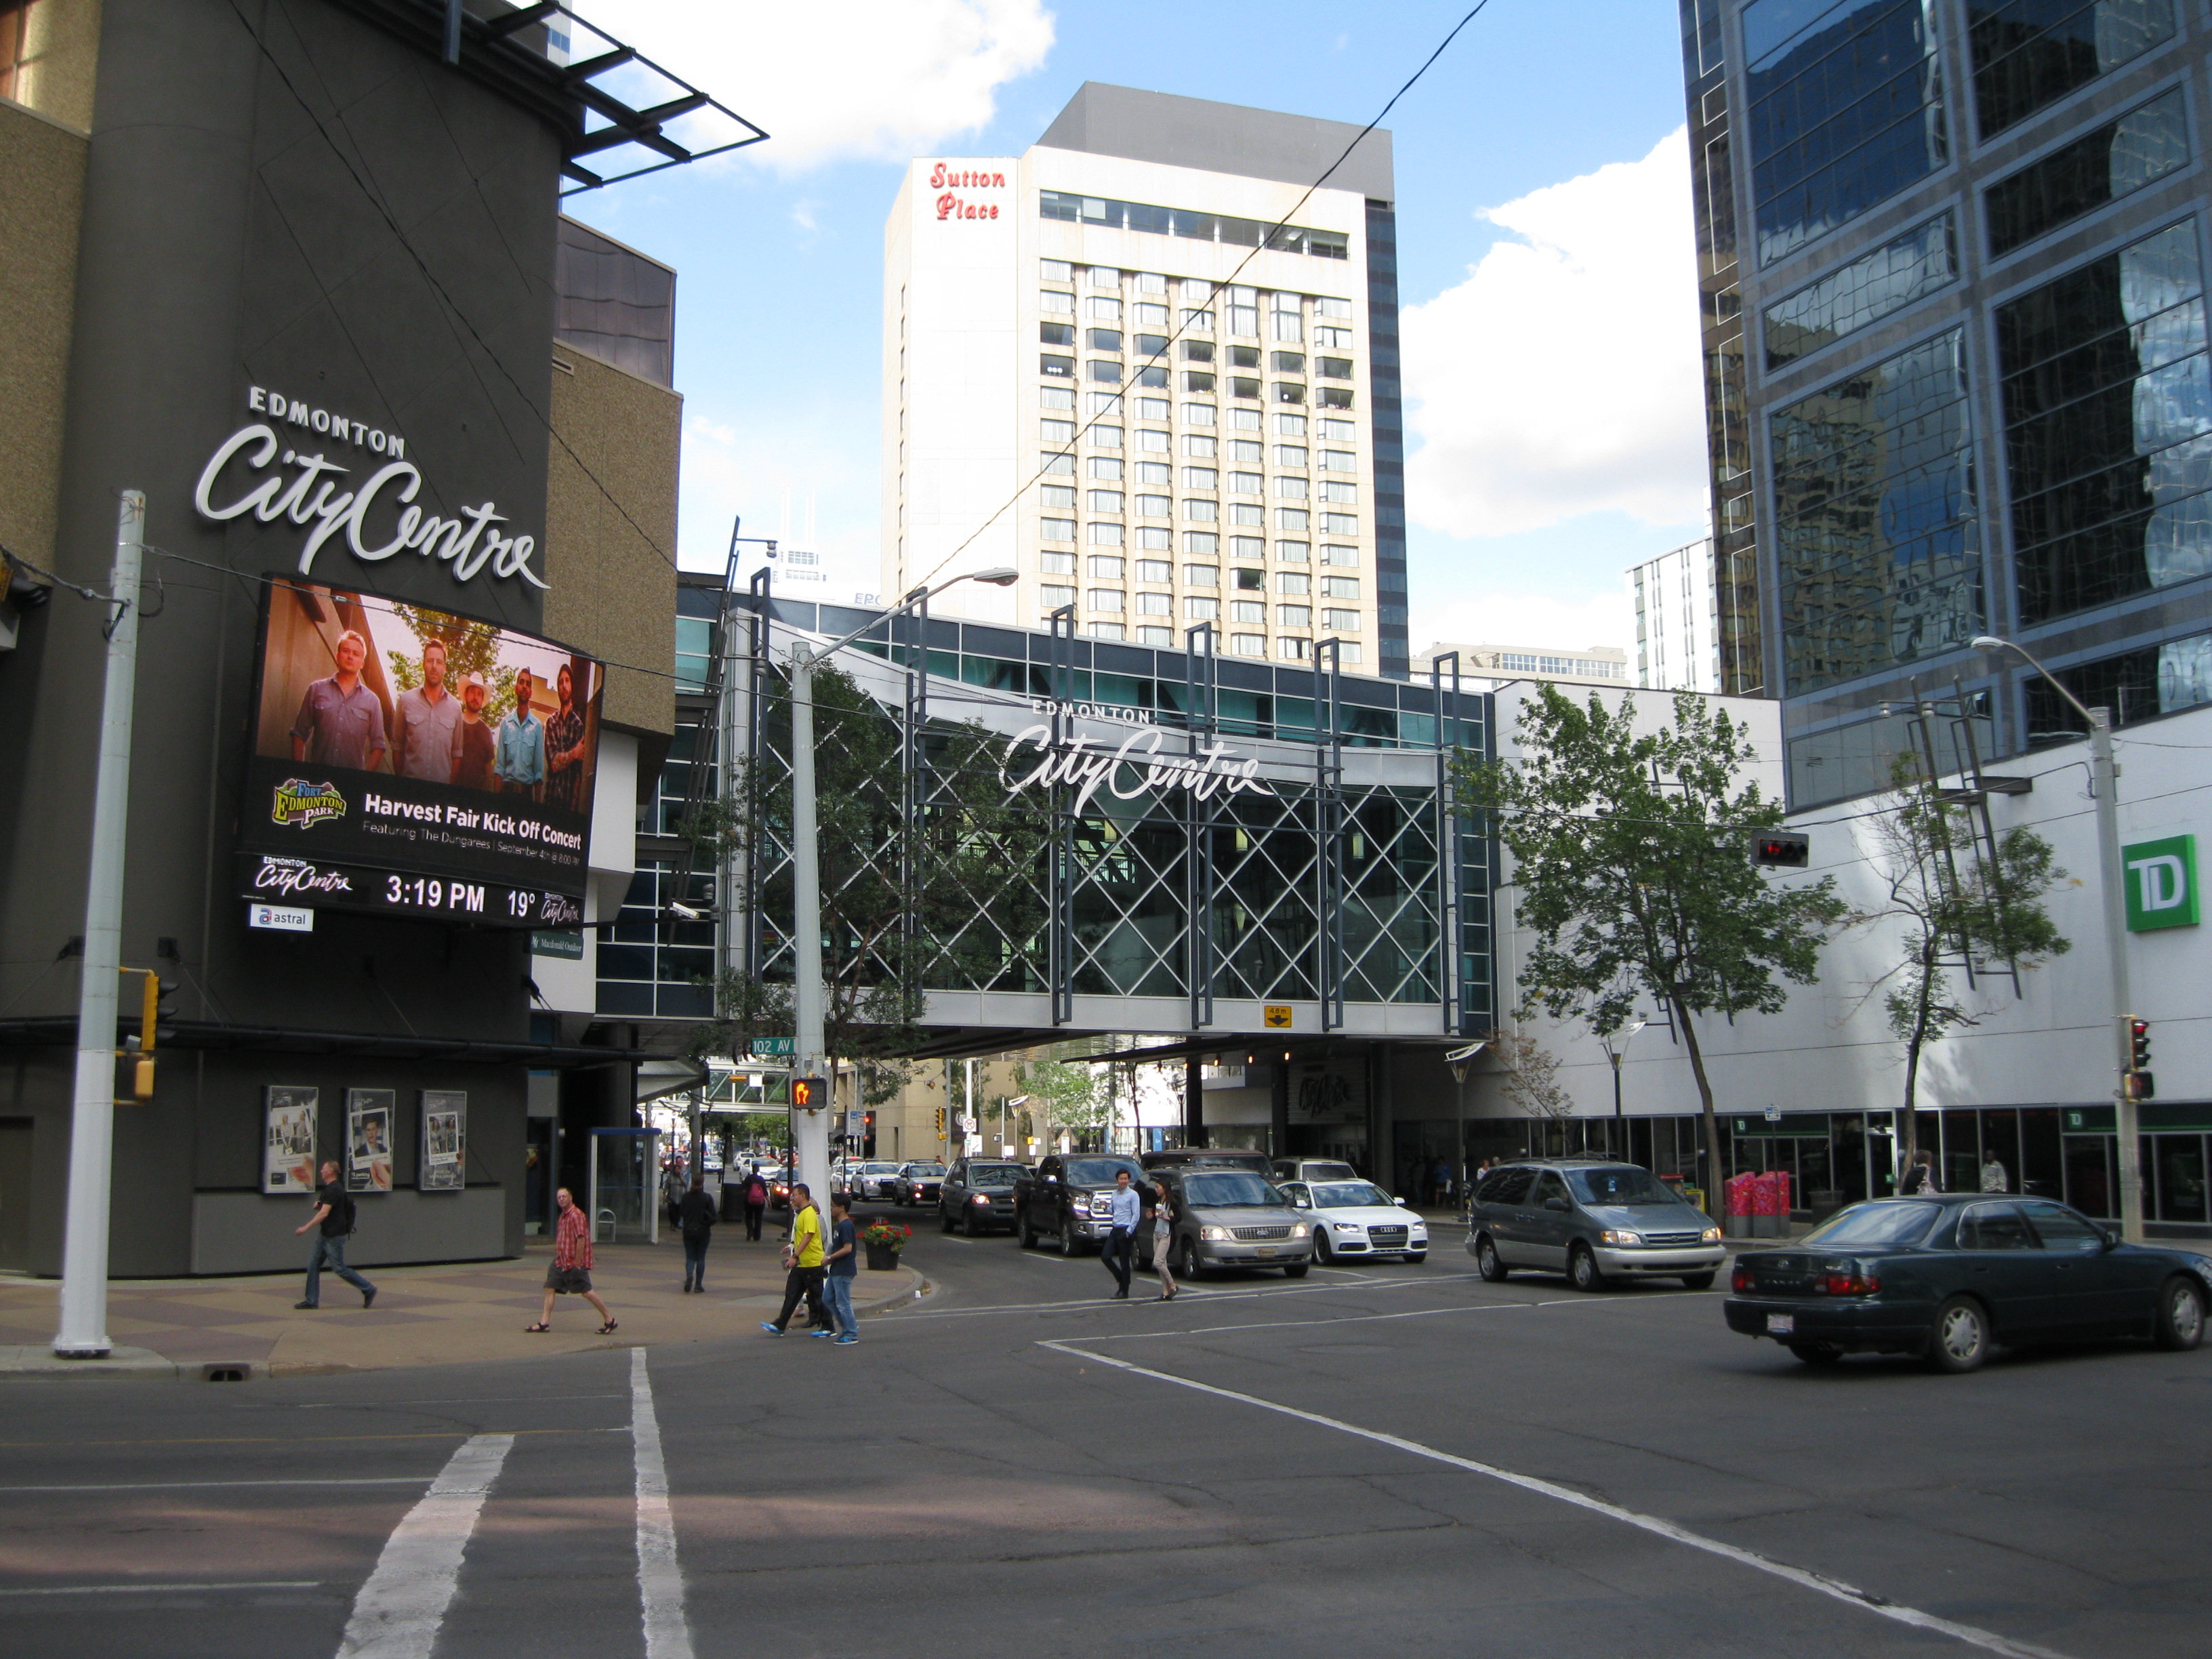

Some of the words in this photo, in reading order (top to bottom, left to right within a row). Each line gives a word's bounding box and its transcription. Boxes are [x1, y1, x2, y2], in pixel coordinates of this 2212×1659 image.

[930, 162, 1005, 188] Sutton
[937, 191, 998, 220] Place
[249, 386, 405, 460] EDMONTON
[195, 424, 354, 575] City
[346, 462, 552, 589] Centre
[1031, 699, 1151, 724] EDMONTON
[998, 724, 1111, 819] City
[1109, 728, 1275, 802] Centre
[365, 793, 443, 823] Harvest
[446, 806, 480, 829] Fair
[483, 812, 517, 836] Kick
[518, 819, 541, 840] Off
[541, 824, 581, 851] Concert
[363, 821, 417, 840] Featuring
[420, 827, 439, 842] The
[441, 832, 491, 849] Dungarees
[497, 840, 538, 859] September
[264, 856, 307, 867] EDMONTON
[255, 865, 295, 896] City
[293, 866, 353, 892] Centre
[386, 875, 443, 907] 3:19
[449, 882, 485, 912] PM
[2127, 855, 2186, 912] TD
[274, 914, 306, 924] astral
[753, 1040, 772, 1052] 102
[777, 1039, 791, 1052] AV
[1737, 1120, 1746, 1130] TD
[2069, 1113, 2082, 1125] TD
